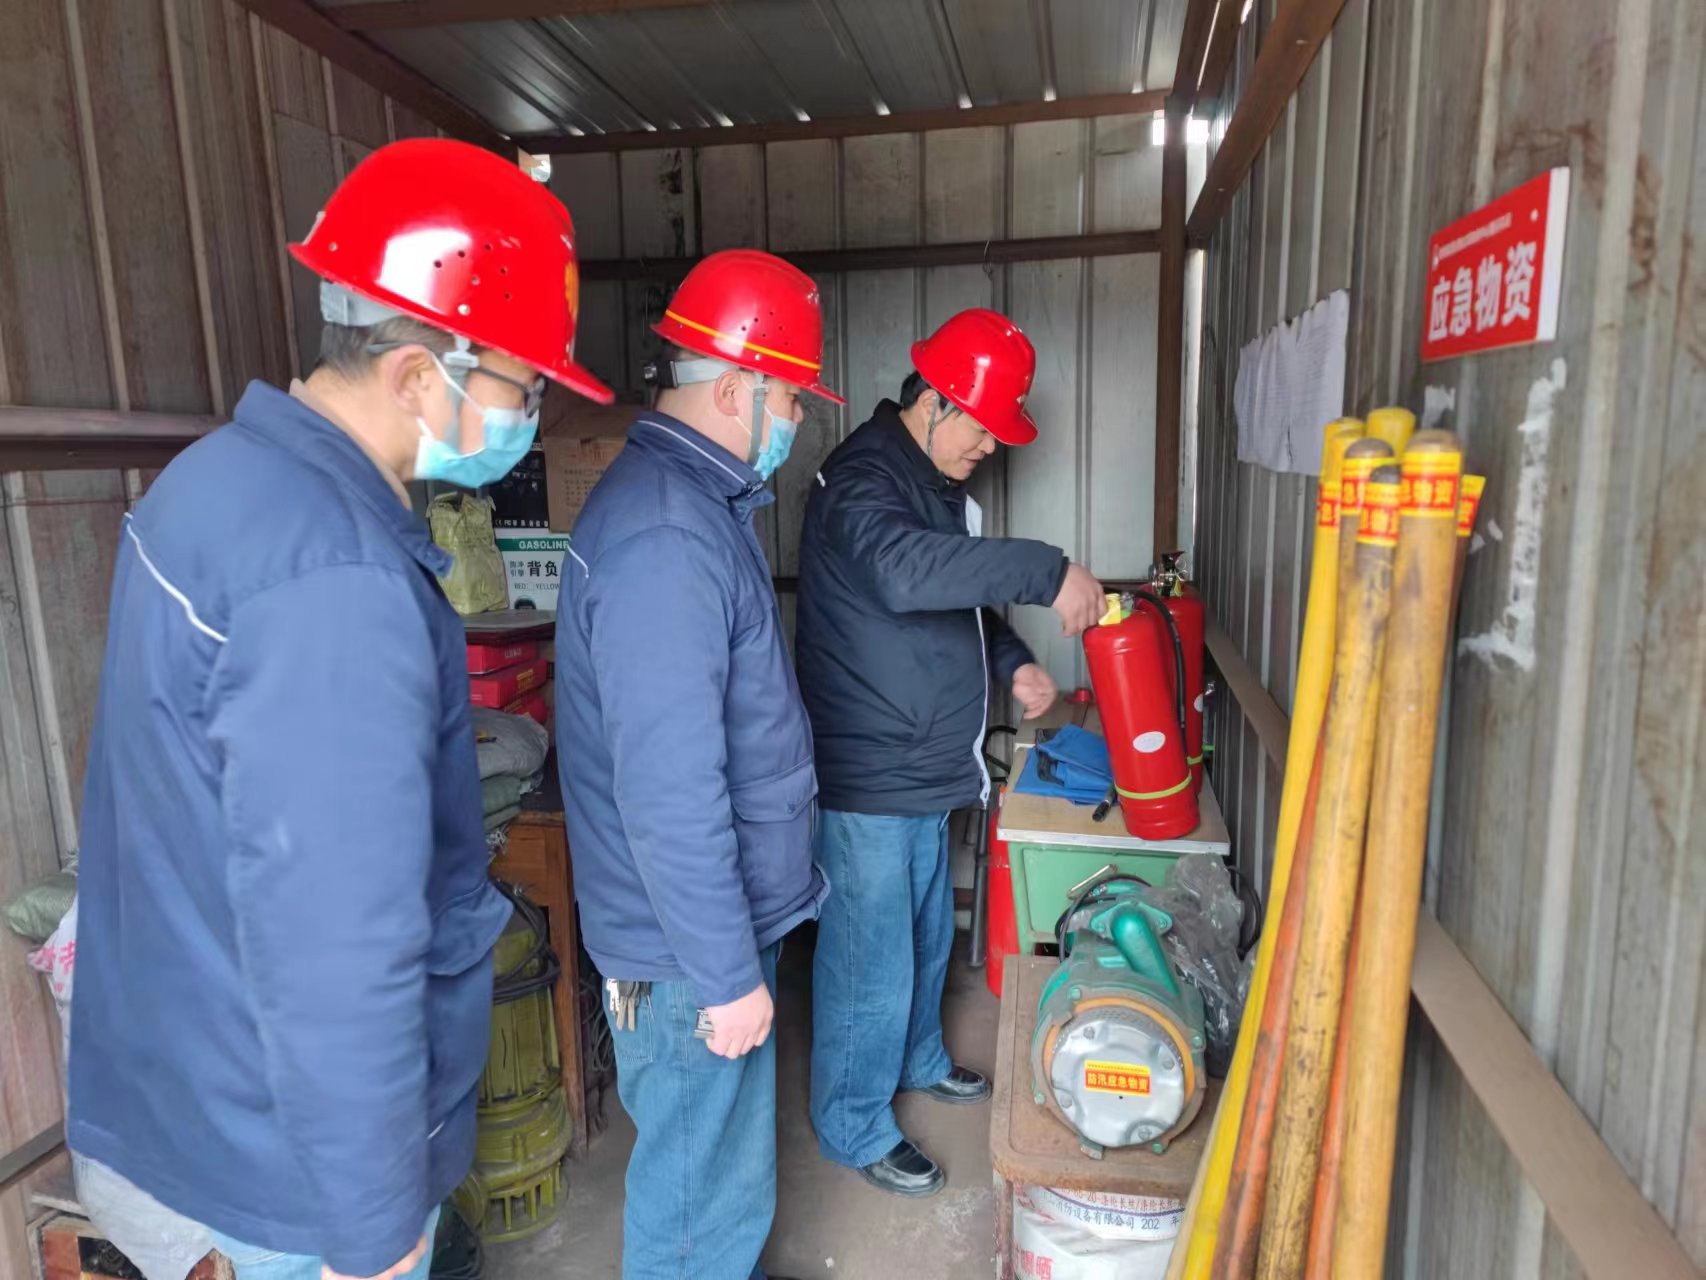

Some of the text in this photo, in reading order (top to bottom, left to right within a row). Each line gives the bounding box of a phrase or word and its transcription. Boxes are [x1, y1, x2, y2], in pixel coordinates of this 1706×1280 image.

[1428, 241, 1537, 343] 应急物资
[527, 559, 558, 577] 背负
[1141, 1218, 1160, 1230] 202
